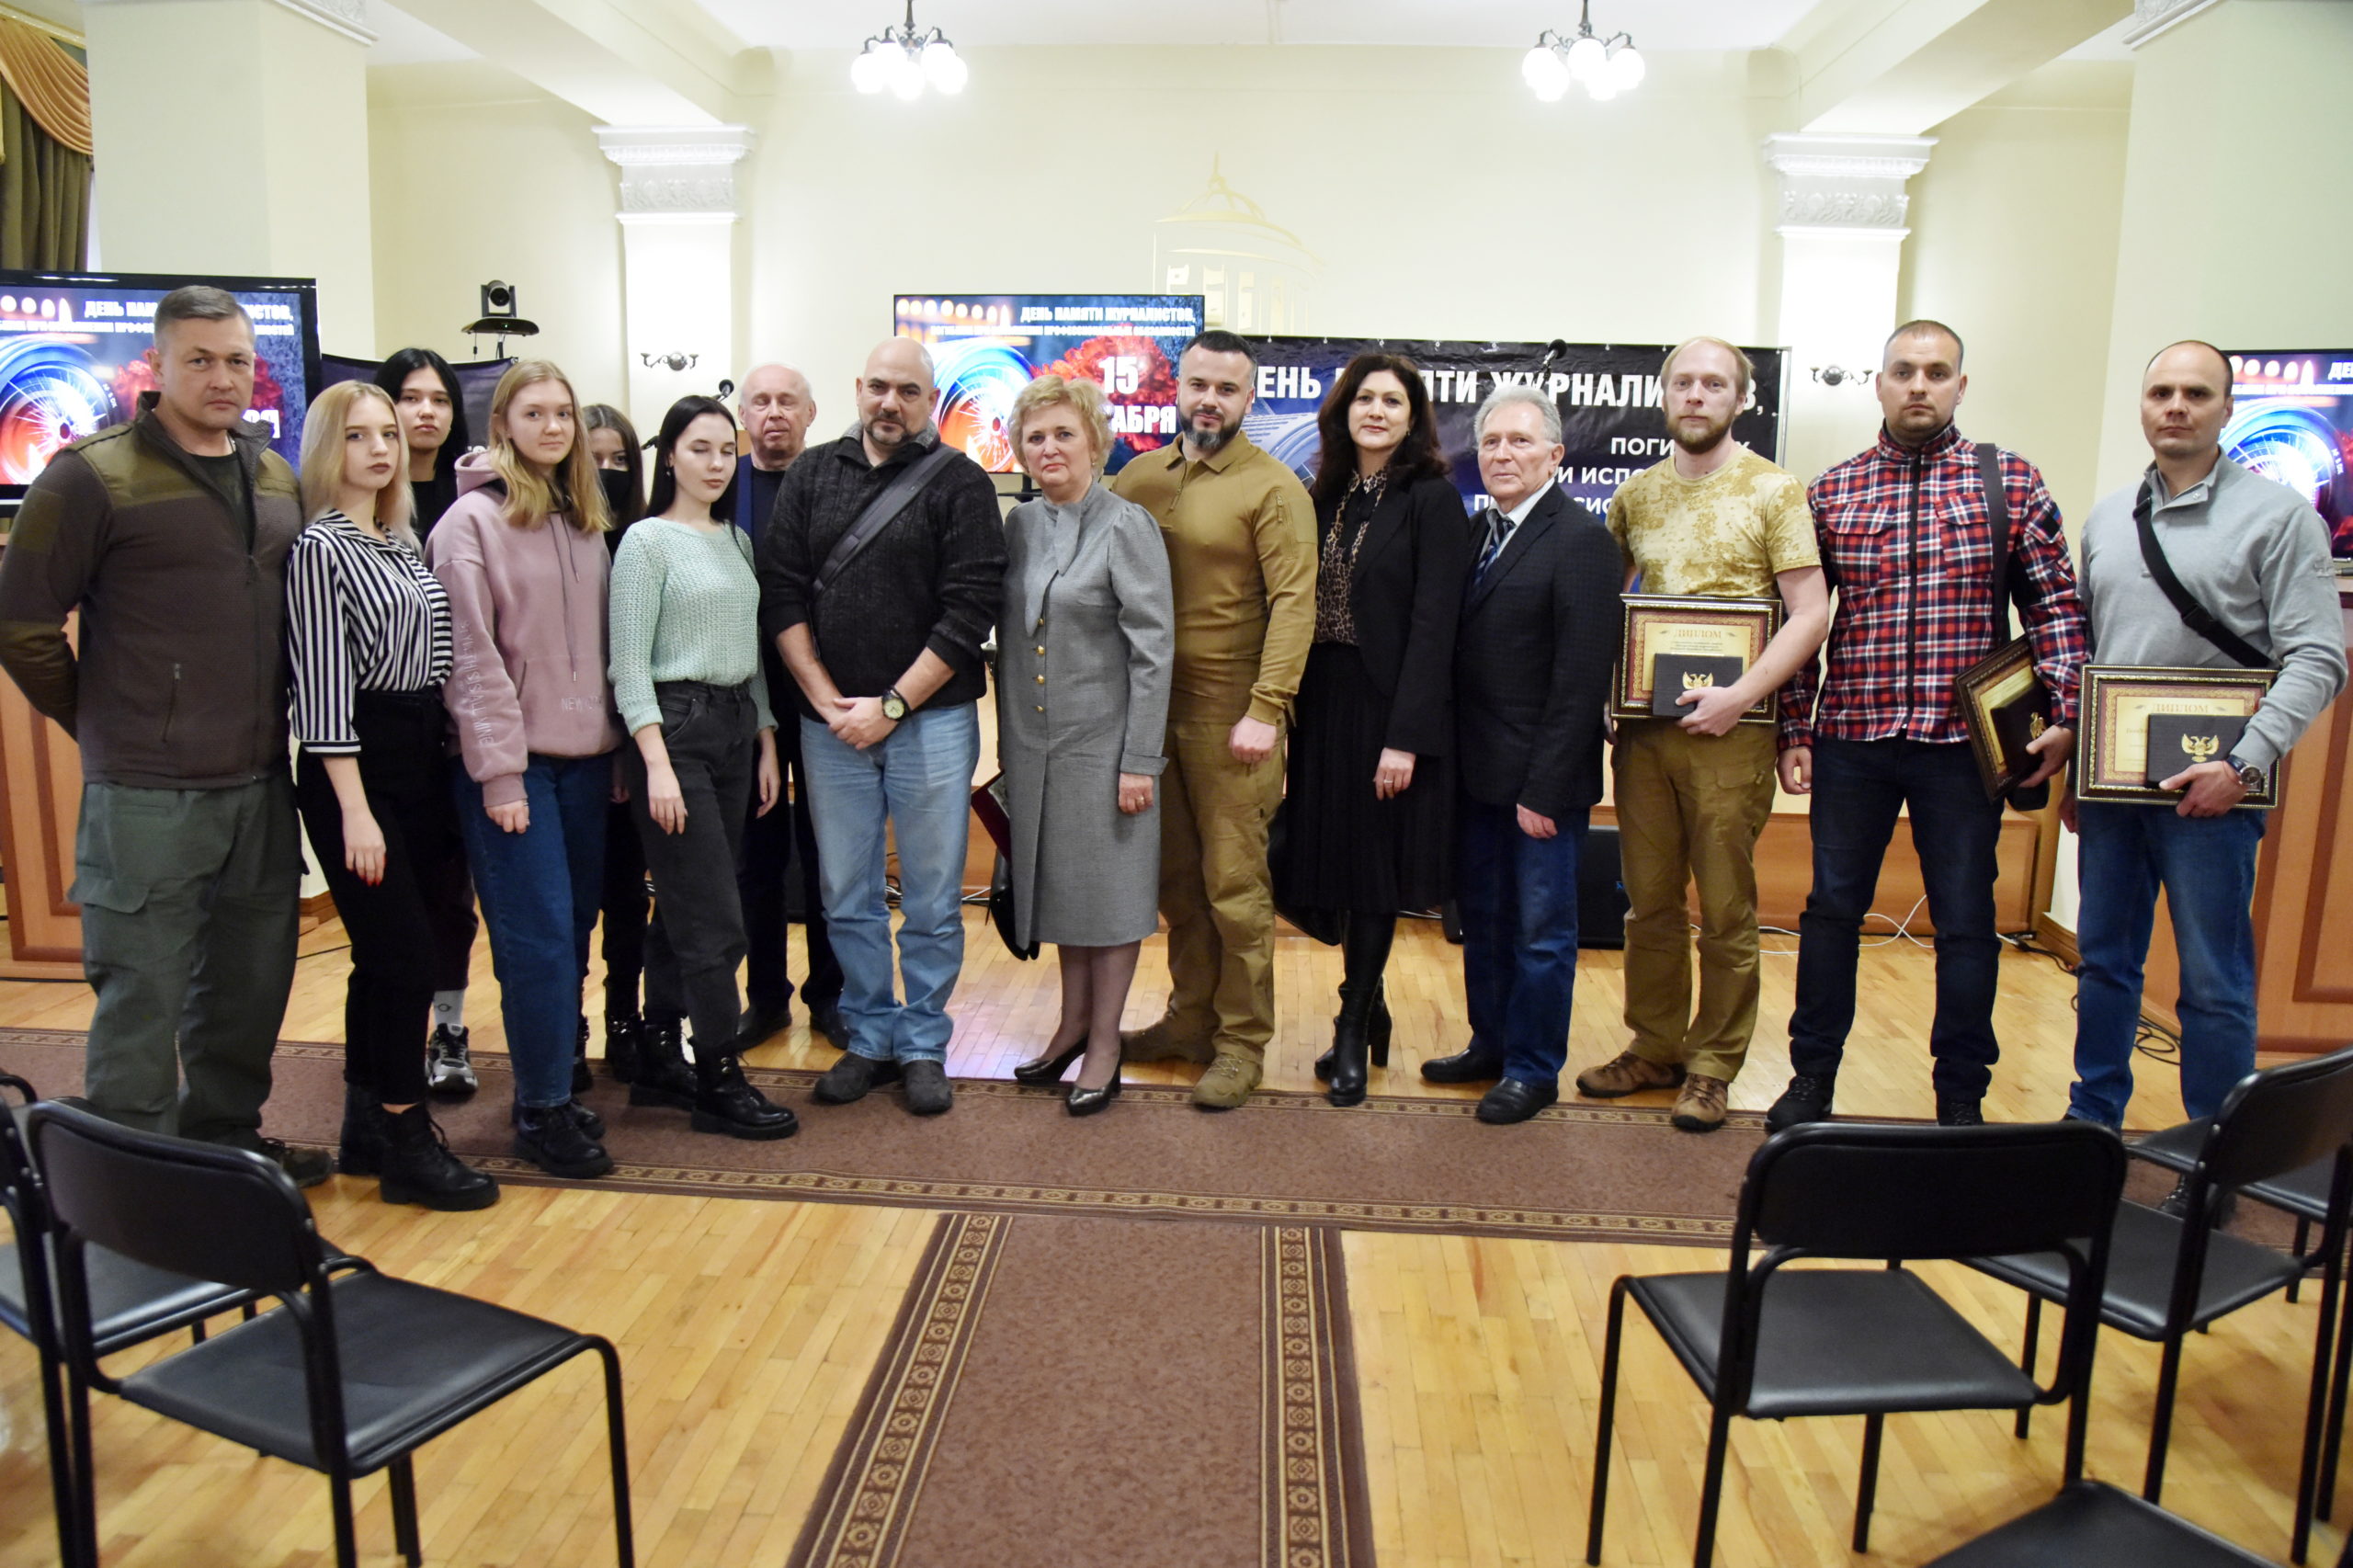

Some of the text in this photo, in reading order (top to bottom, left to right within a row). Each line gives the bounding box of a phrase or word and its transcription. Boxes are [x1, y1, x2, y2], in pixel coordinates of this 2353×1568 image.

[1020, 307, 1052, 323] ДЕНЬ
[1054, 307, 1103, 321] ПАМЯТИ
[1099, 356, 1139, 394] 15
[1252, 365, 1322, 403] ЕНЬ
[1110, 405, 1176, 434] АБРЯ
